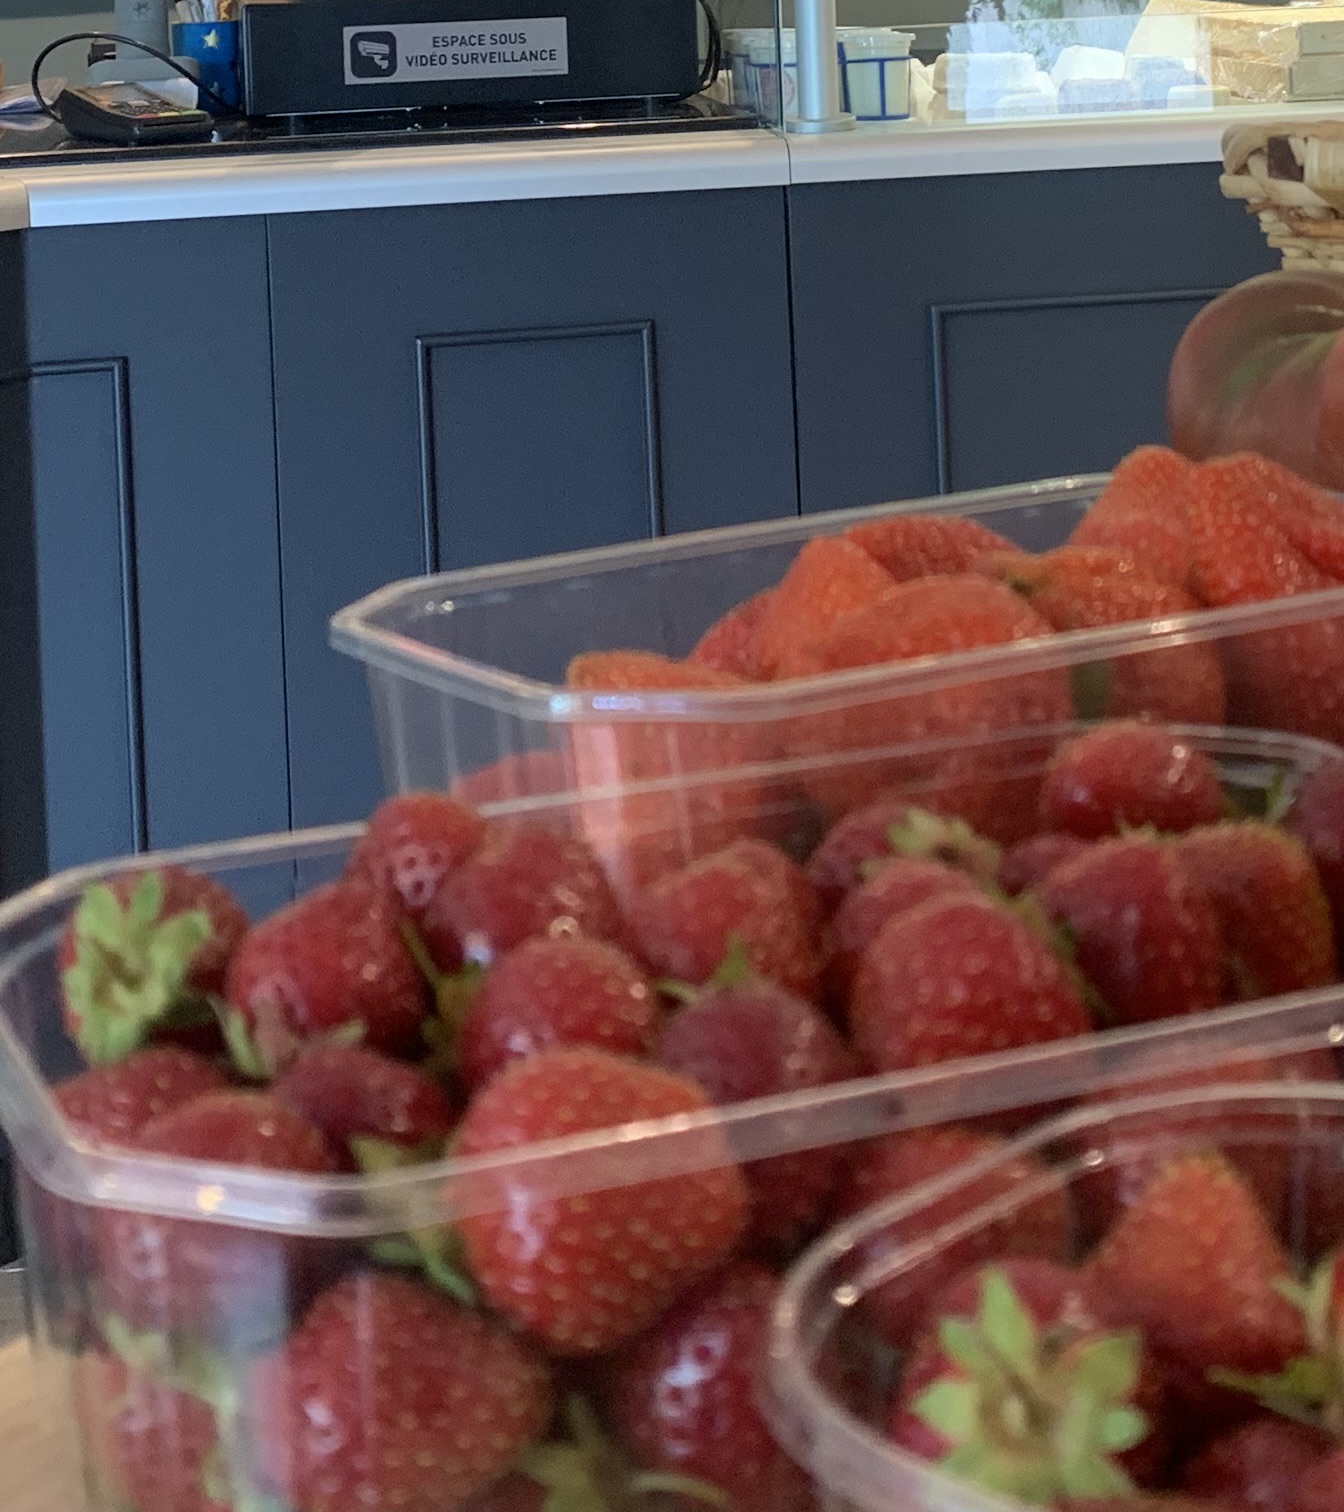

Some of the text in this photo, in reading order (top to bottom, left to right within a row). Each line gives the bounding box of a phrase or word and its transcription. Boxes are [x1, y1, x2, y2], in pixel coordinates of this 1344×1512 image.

[432, 33, 527, 48] ESPACE SOUS
[405, 49, 557, 67] VIDÉO SURVEILLANCE
